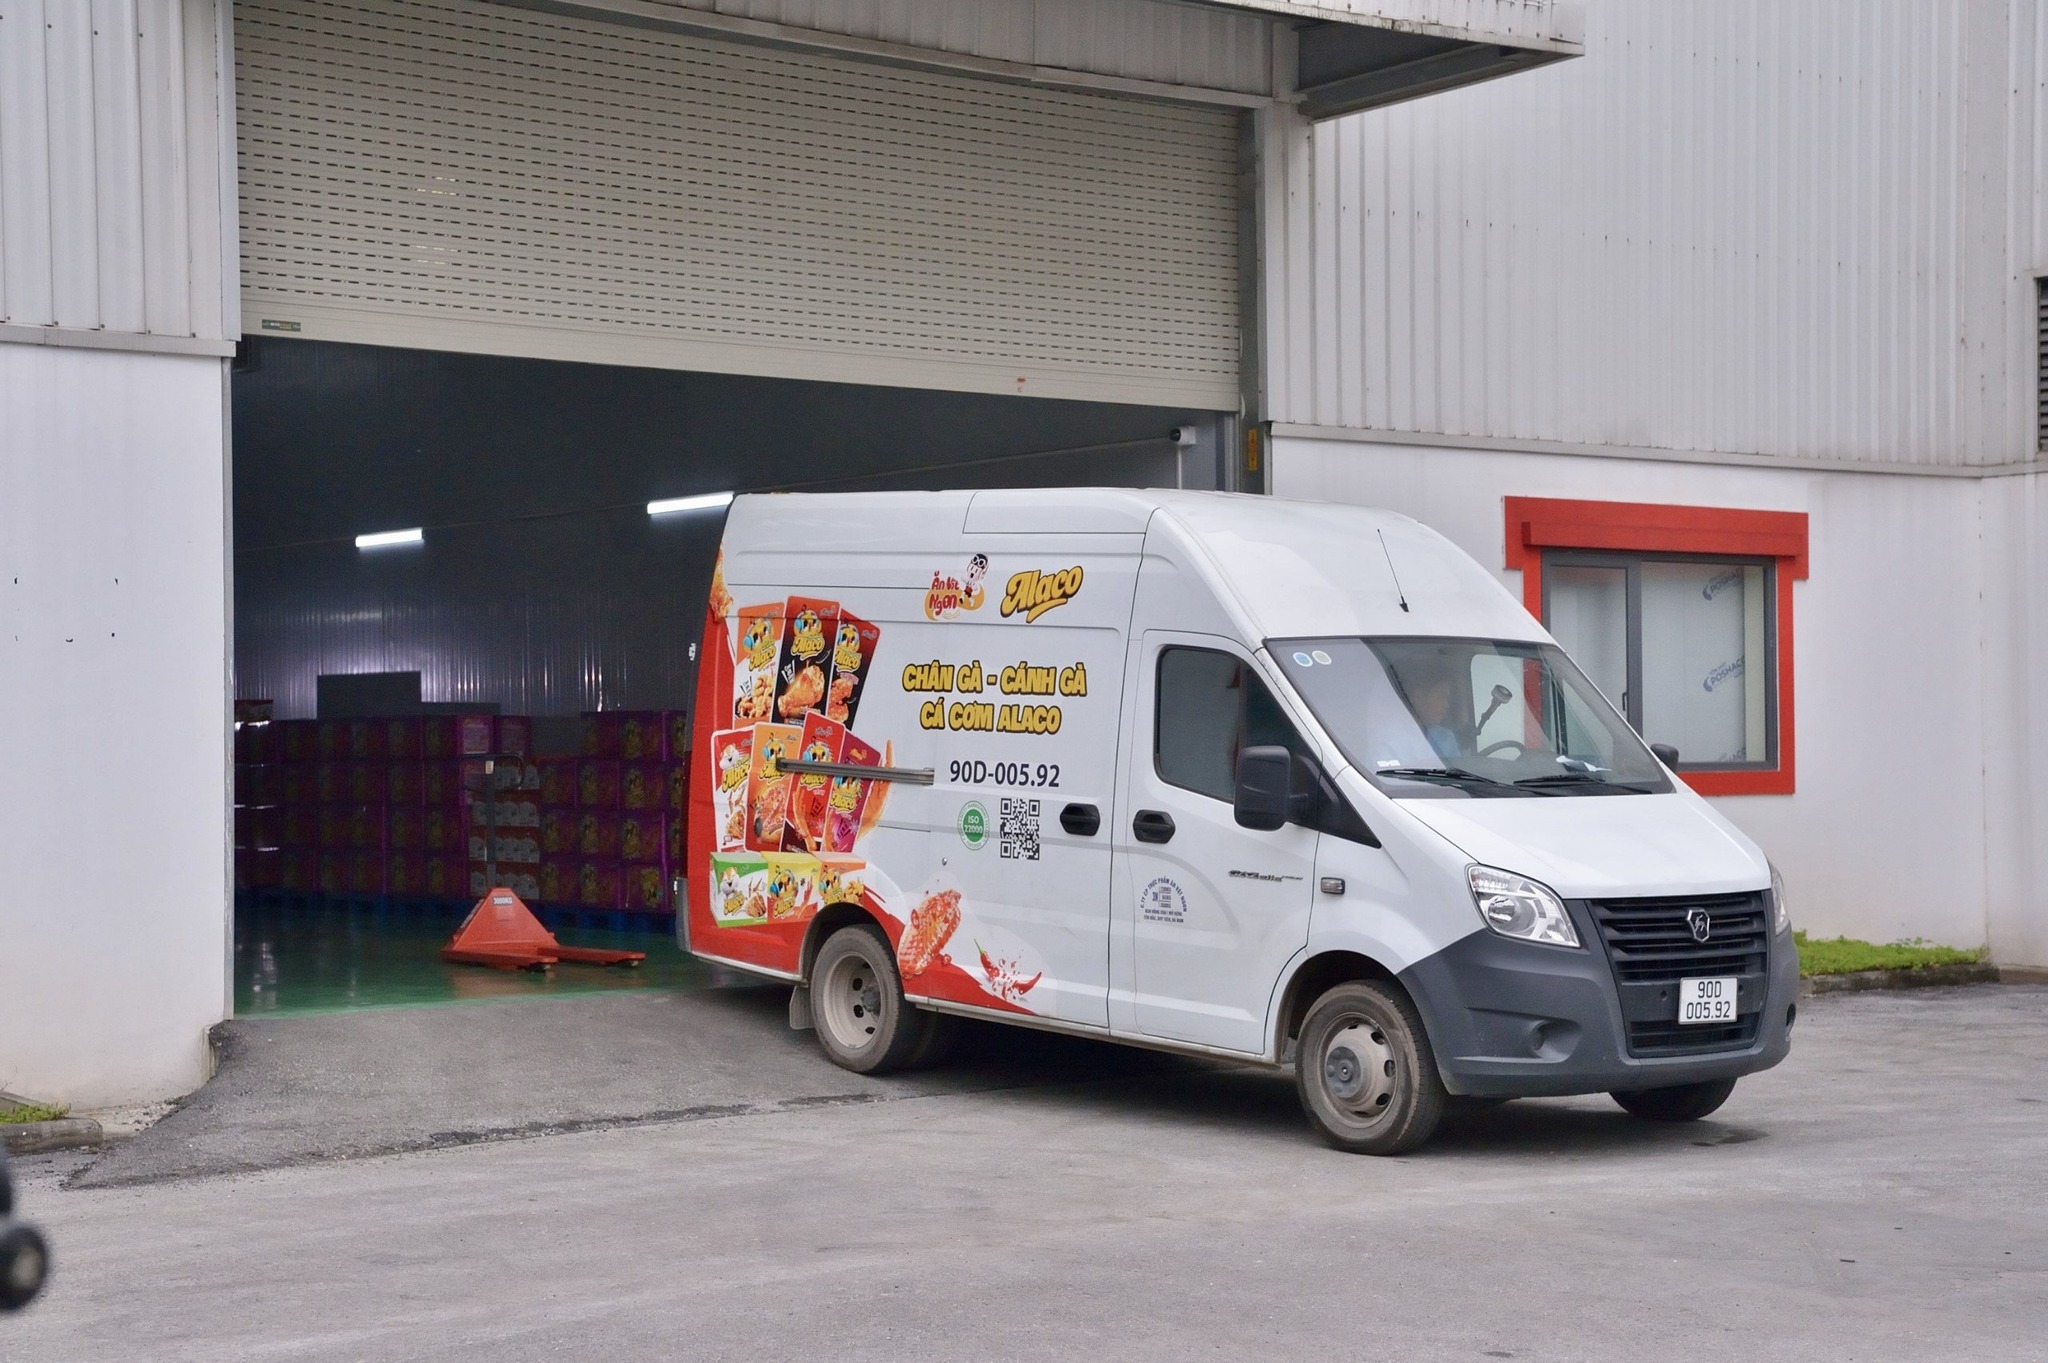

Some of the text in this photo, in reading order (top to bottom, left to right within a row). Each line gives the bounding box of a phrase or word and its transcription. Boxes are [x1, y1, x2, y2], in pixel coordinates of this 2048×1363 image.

[1000, 566, 1083, 619] Alaco
[929, 593, 958, 616] Ngon
[749, 645, 776, 671] Alaco
[791, 636, 825, 658] Alaco
[834, 650, 862, 671] Alaco
[902, 659, 955, 692] CHÂN
[956, 660, 983, 693] GÀ
[1000, 661, 1057, 695] CÁNH
[1059, 662, 1087, 697] GÀ
[920, 697, 1062, 735] CÁ CƠM ALACO
[950, 760, 1060, 787] 90D-005.92
[964, 825, 983, 834] 22000
[967, 815, 980, 824] ISO
[1697, 981, 1722, 999] 90D
[1686, 1001, 1731, 1020] 005.92
